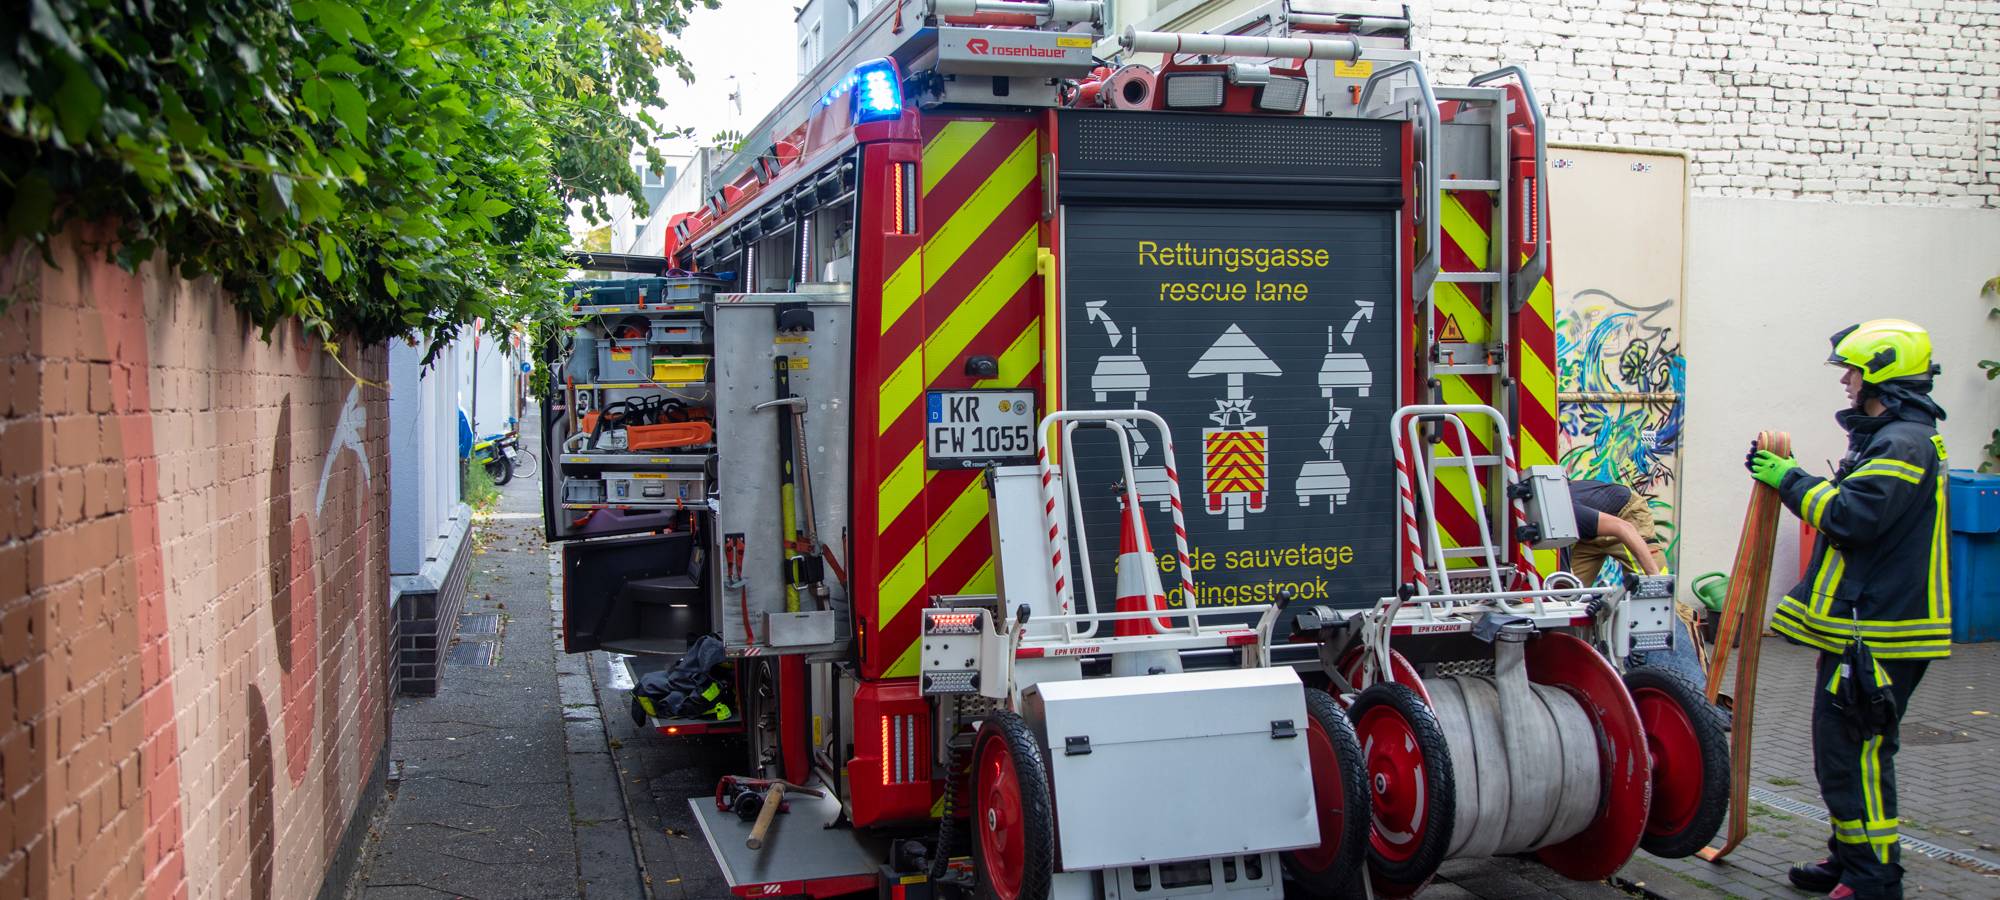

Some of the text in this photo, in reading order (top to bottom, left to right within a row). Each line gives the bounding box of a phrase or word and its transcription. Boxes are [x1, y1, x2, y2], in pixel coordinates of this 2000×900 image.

[991, 45, 1067, 58] rosenbauer
[1138, 240, 1330, 273] Rettungsgasse
[1159, 280, 1309, 302] rescue lane
[932, 411, 939, 420] D
[950, 396, 980, 423] KR
[935, 425, 1029, 453] FW 1055
[1188, 547, 1217, 571] de
[1224, 543, 1354, 571] sauvetage
